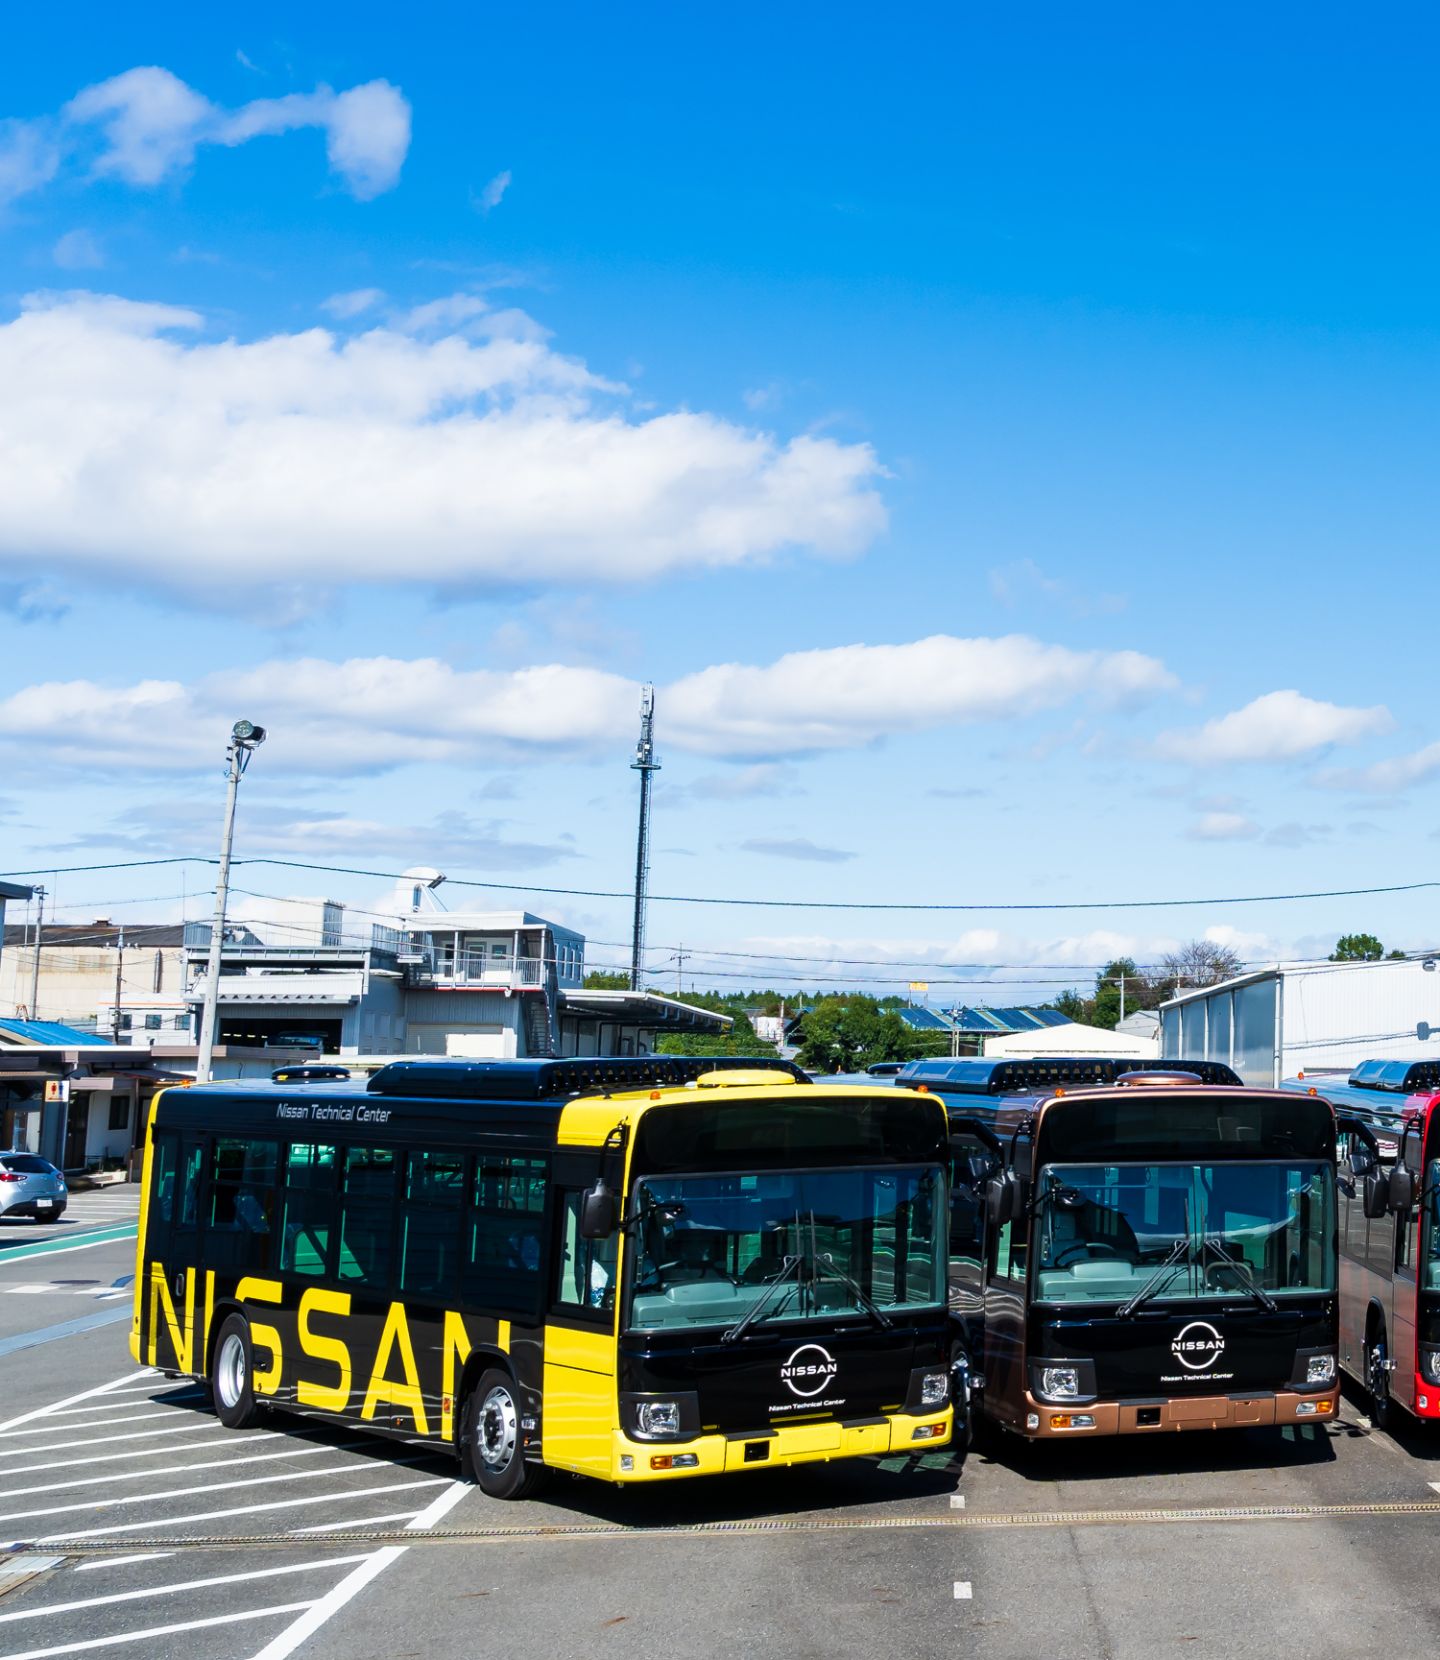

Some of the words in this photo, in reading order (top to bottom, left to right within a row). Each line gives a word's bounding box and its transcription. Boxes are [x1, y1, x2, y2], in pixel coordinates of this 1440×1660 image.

[276, 1103, 308, 1119] Nissan
[311, 1104, 355, 1120] Technical
[356, 1105, 392, 1122] Center
[147, 1262, 511, 1441] NISSAN
[1170, 1340, 1225, 1351] NISSAN
[780, 1363, 838, 1377] NISSAN
[793, 1401, 822, 1409] Technical
